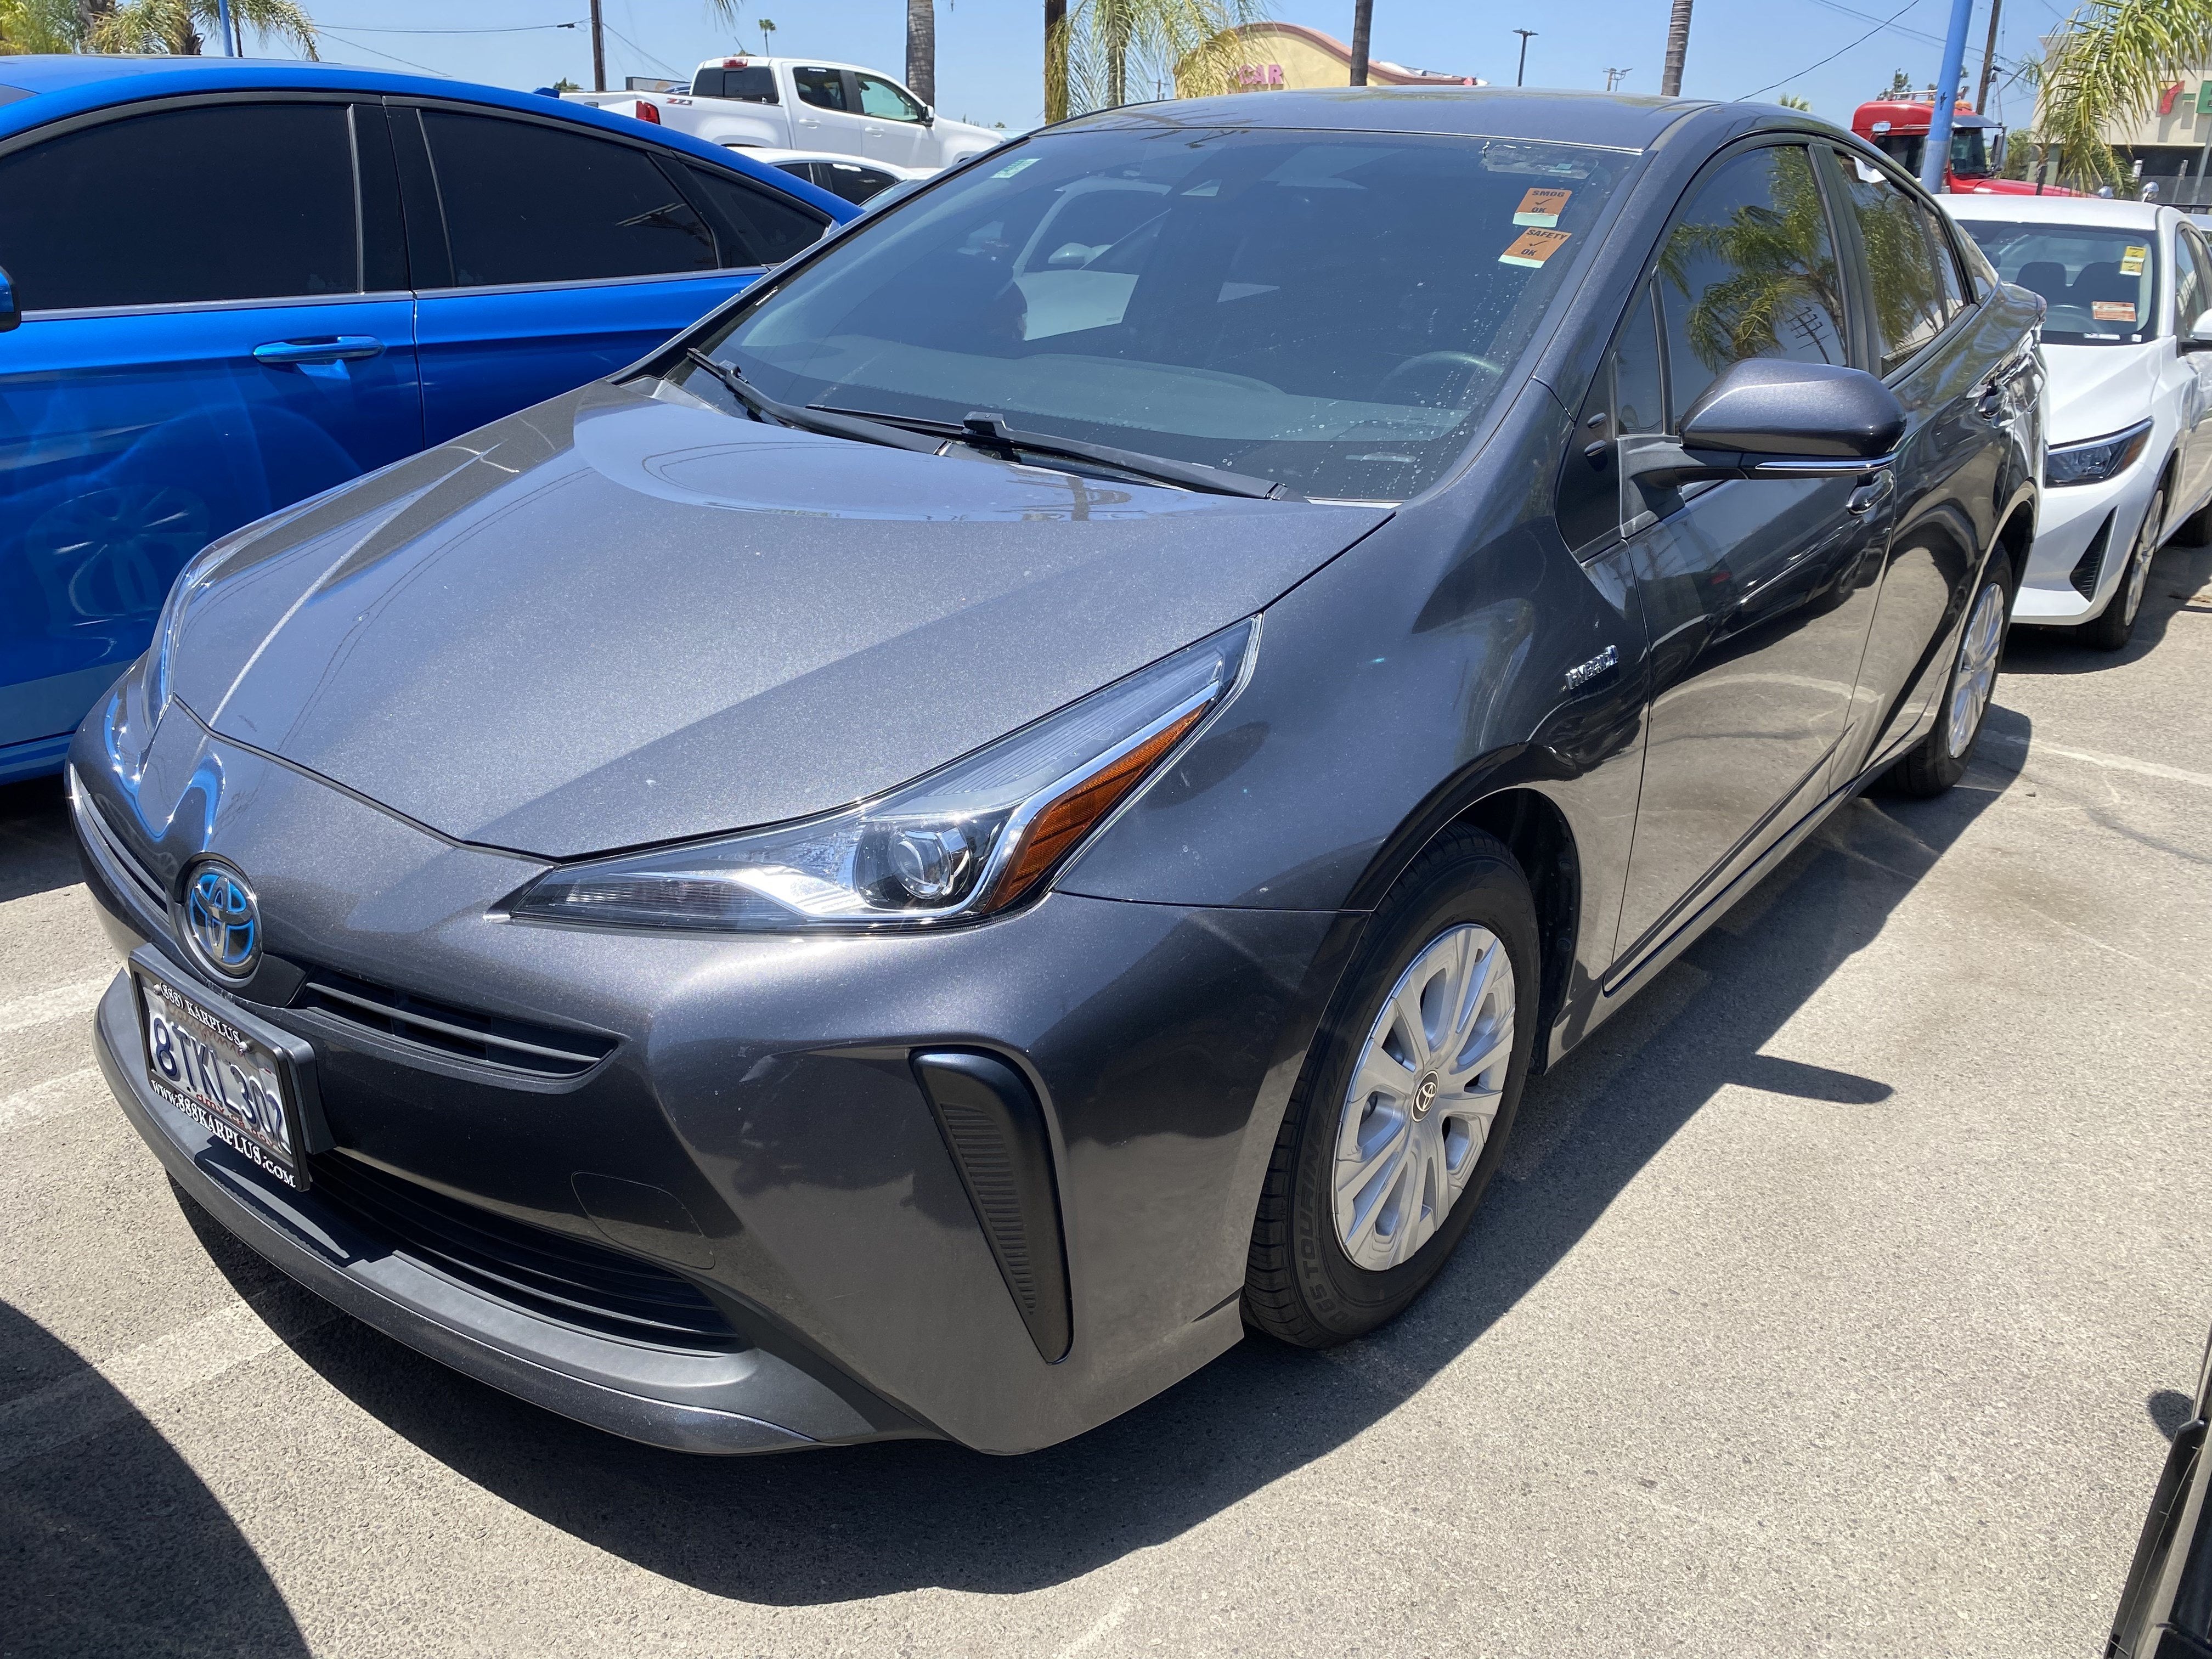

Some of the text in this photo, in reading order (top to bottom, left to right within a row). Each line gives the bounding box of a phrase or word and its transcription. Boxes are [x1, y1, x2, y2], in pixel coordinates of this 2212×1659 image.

[1239, 64, 1283, 84] CAR
[1526, 229, 1568, 240] SAFETY
[160, 982, 241, 1045] (888) KARPLUS
[1299, 1109, 1325, 1279] TOURING
